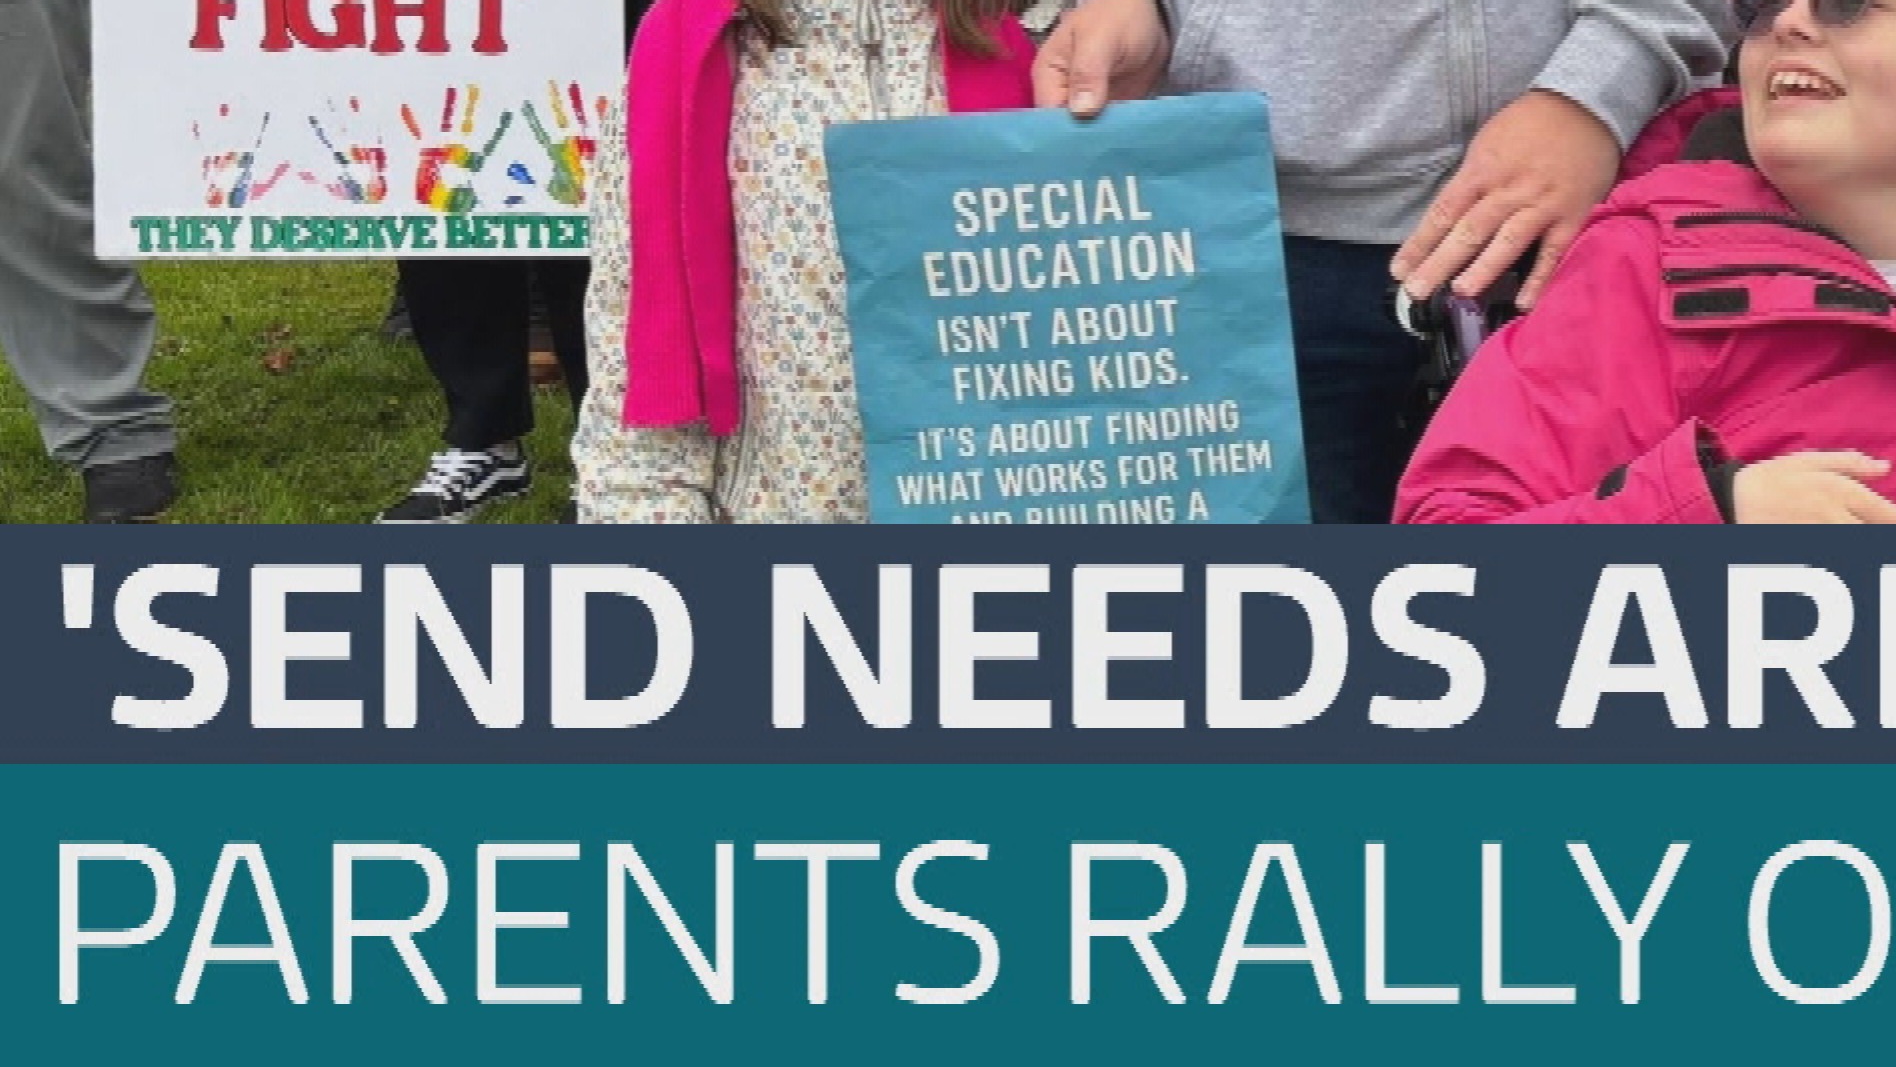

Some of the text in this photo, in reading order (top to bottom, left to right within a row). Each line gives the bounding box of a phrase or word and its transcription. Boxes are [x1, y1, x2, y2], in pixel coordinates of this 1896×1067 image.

[131, 215, 241, 252] THEY
[250, 215, 437, 252] DESERVE
[952, 175, 1152, 237] SPECIAL
[923, 228, 1195, 298] EDUCATION
[937, 299, 1178, 356] ISN'T ABOUT
[953, 348, 1190, 403] FIXING KIDS.
[918, 400, 1240, 461] IT'S ABOUT FINDING
[897, 439, 1273, 506] WHAT WORKS FOR THEM
[1187, 488, 1210, 521] A
